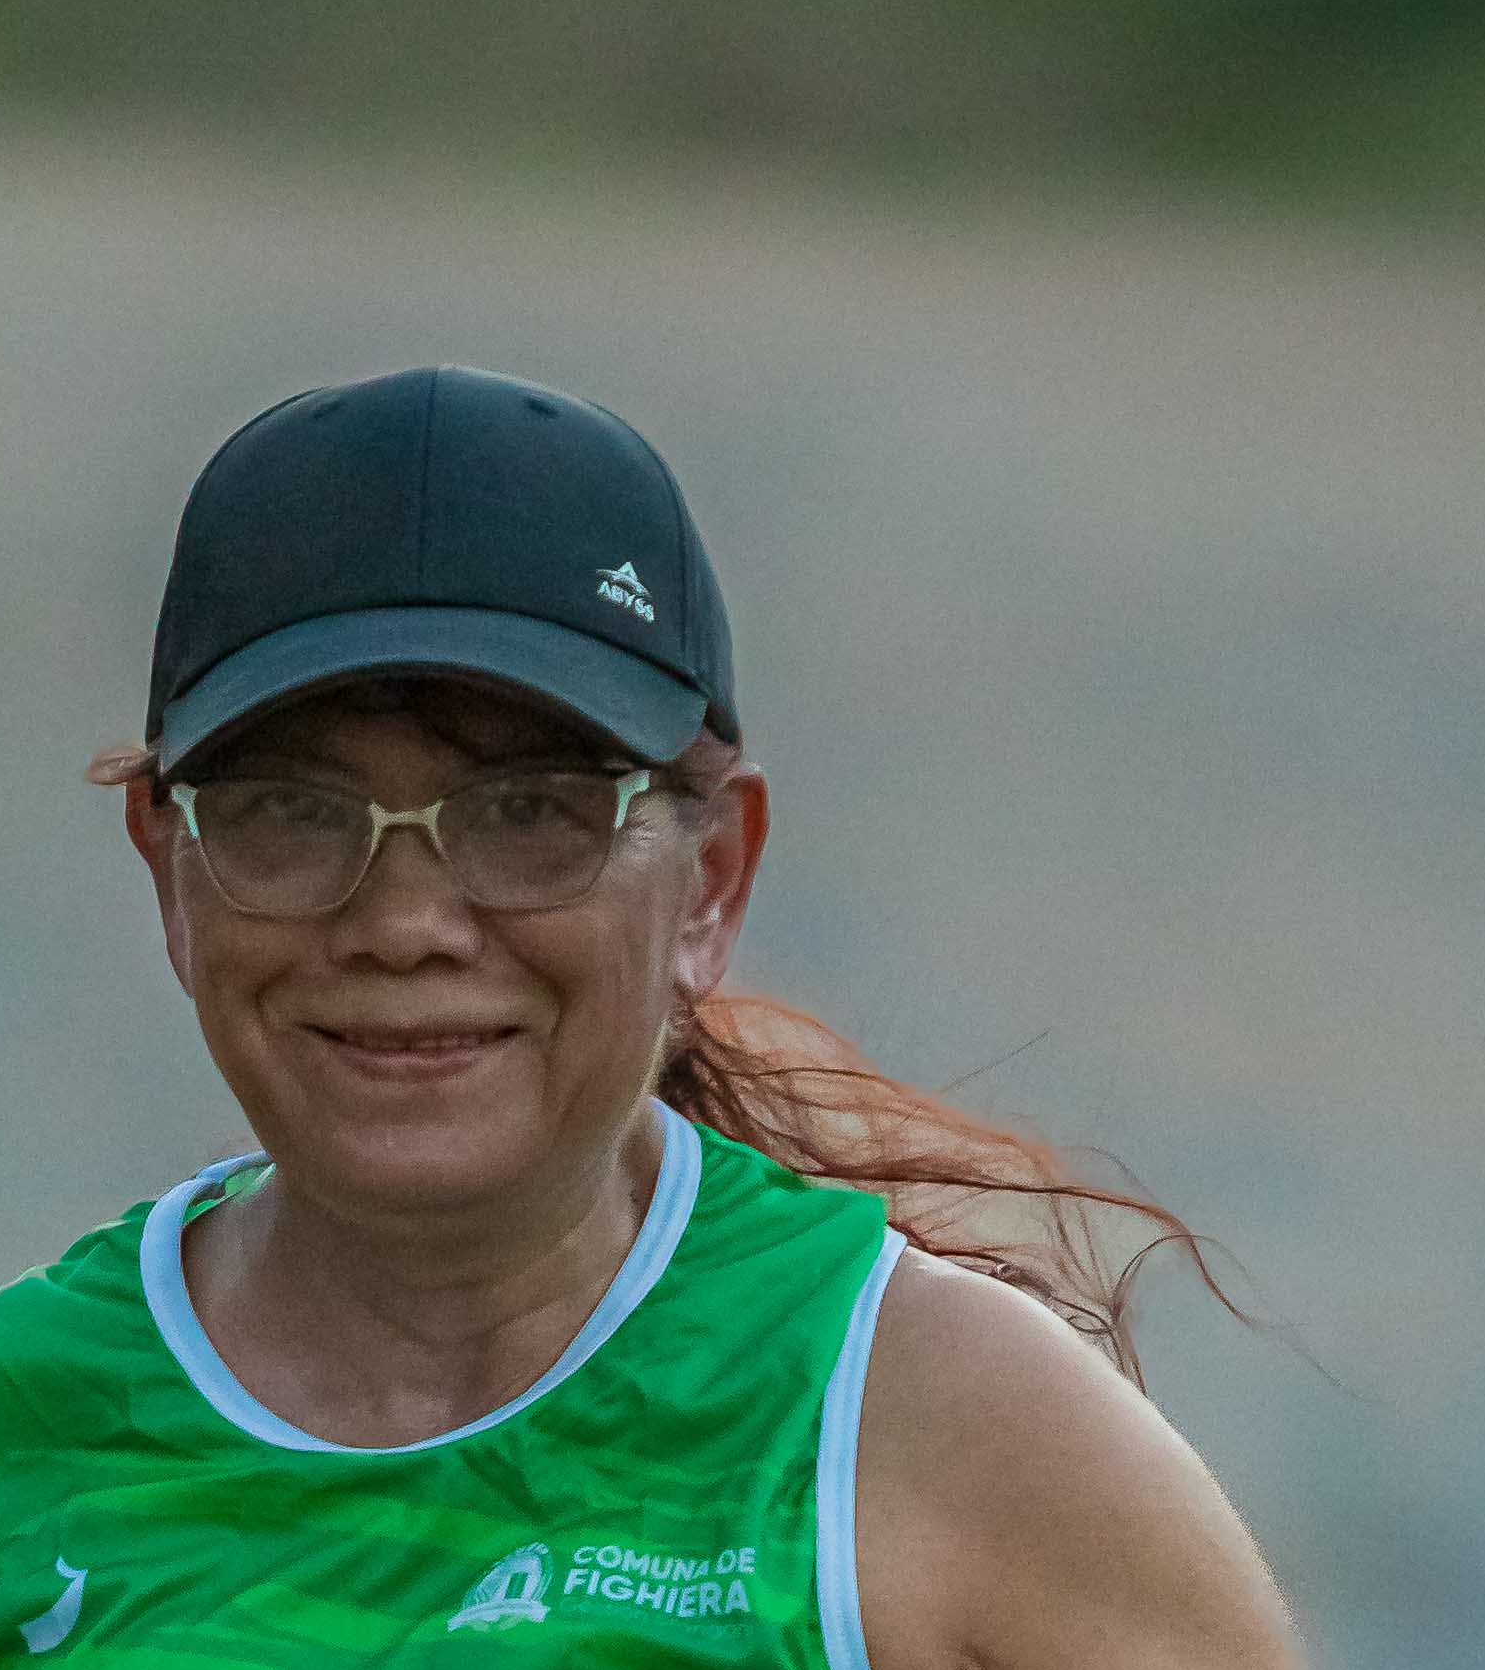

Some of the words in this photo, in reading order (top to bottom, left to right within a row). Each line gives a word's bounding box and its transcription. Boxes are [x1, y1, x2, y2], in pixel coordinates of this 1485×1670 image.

[572, 1545, 709, 1580] COMUNA
[714, 1547, 757, 1576] DE
[563, 1568, 751, 1618] FIGHIERA
